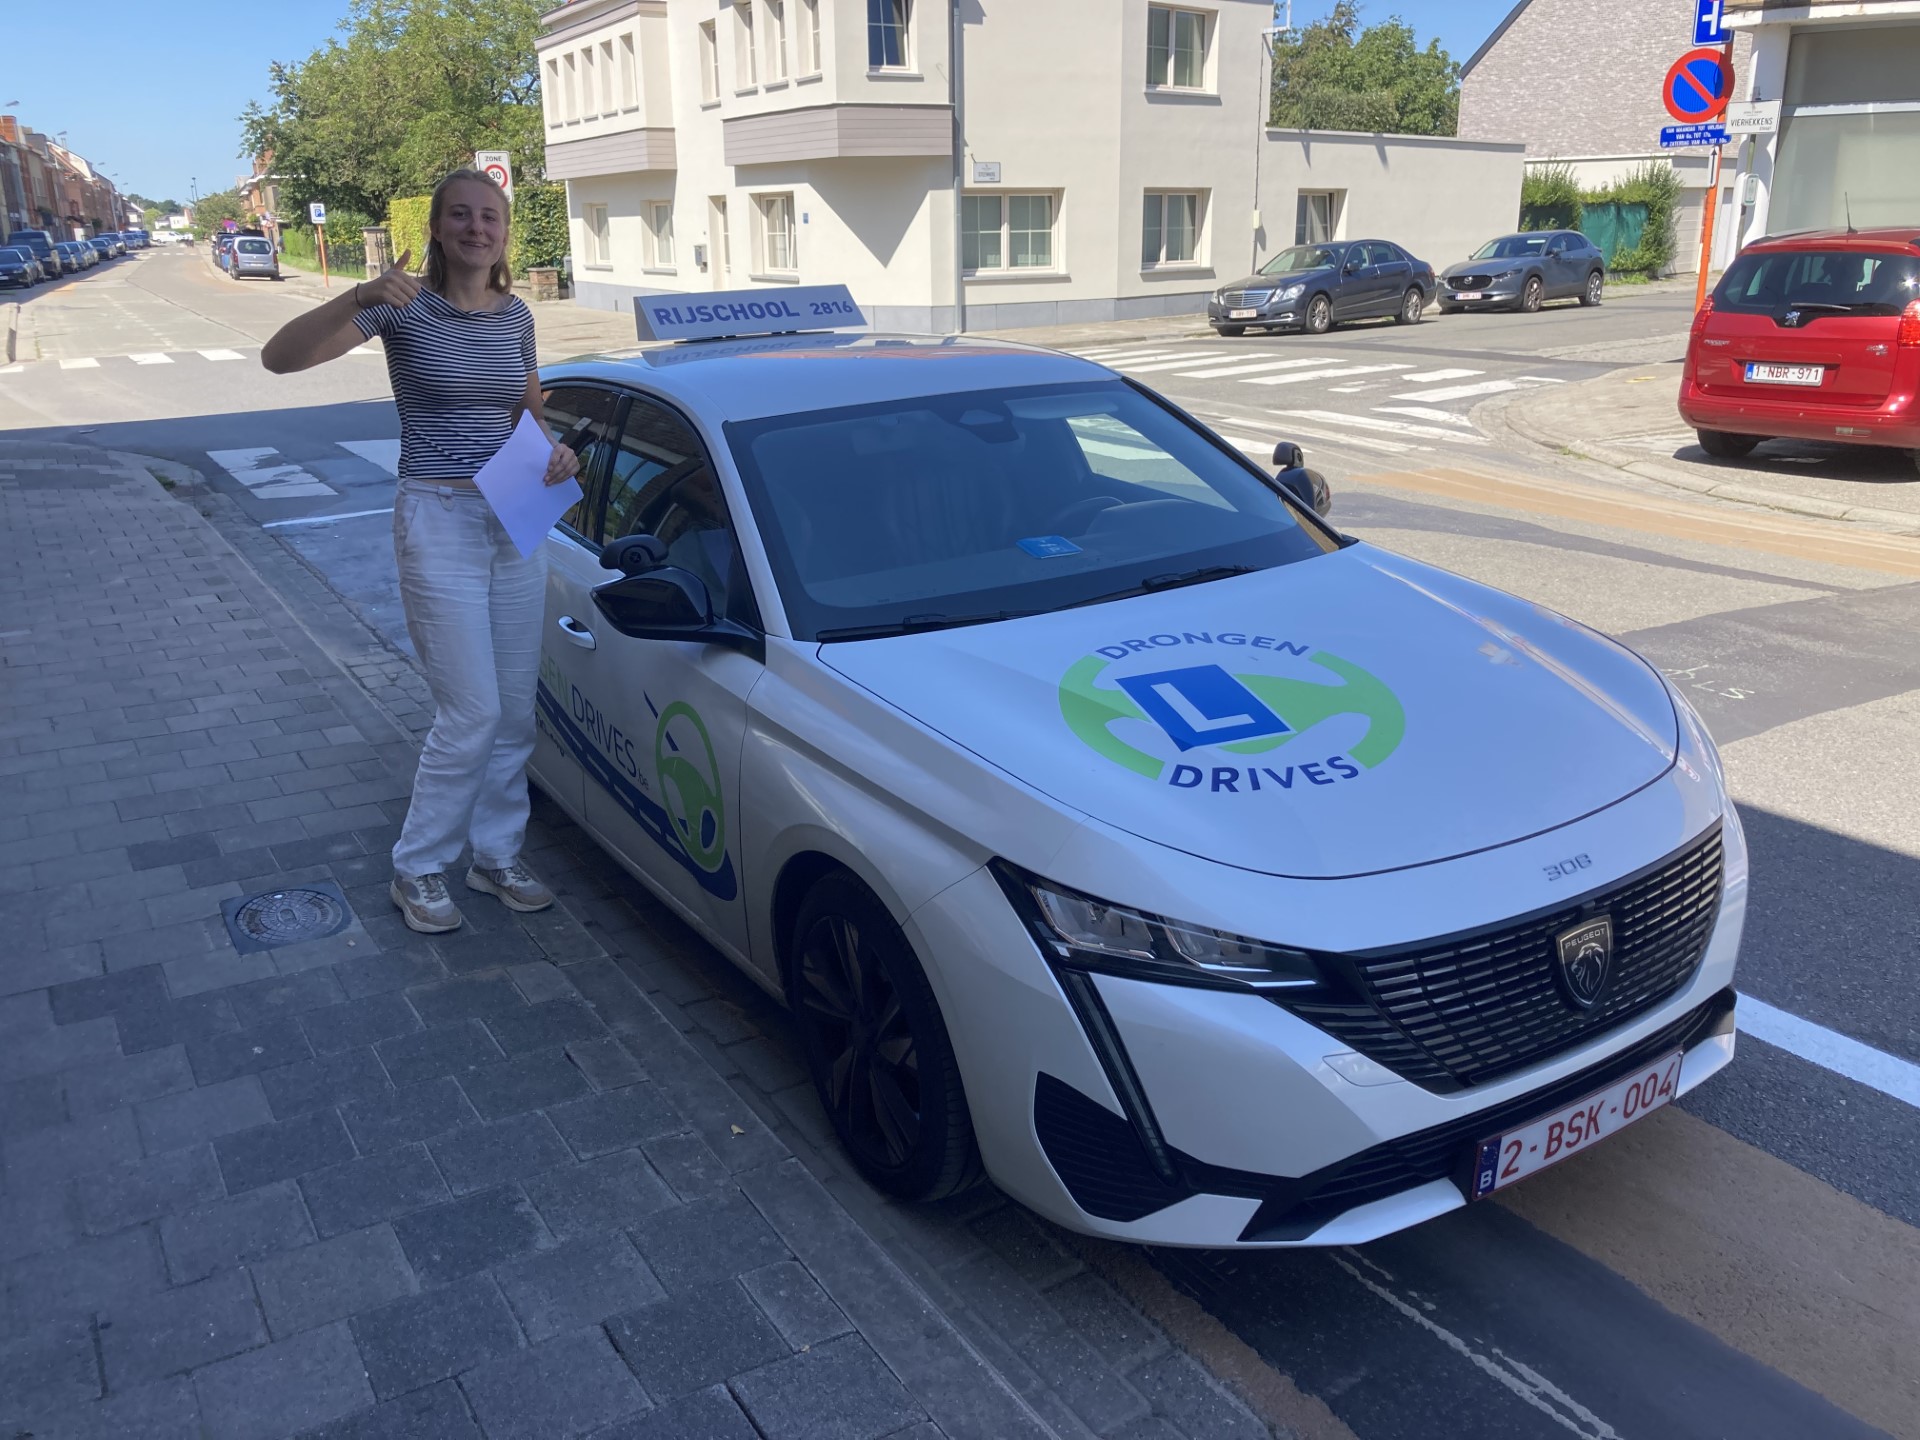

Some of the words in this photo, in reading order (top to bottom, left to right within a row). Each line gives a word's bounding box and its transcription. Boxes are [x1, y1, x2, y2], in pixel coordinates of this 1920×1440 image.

[1730, 117, 1774, 127] VIERHEKKENS
[490, 171, 501, 180] 30
[653, 301, 800, 325] RIJSCHOOL
[809, 300, 853, 316] 2816
[1755, 364, 1819, 381] 1-NBR-971
[1096, 632, 1310, 660] DRONGEN
[1150, 682, 1256, 733] L
[1168, 756, 1360, 792] DRIVES
[1542, 853, 1592, 881] 308
[1564, 928, 1606, 950] PEUGEOT
[1500, 1061, 1676, 1180] 2-BSK-004
[1479, 1170, 1493, 1190] B
